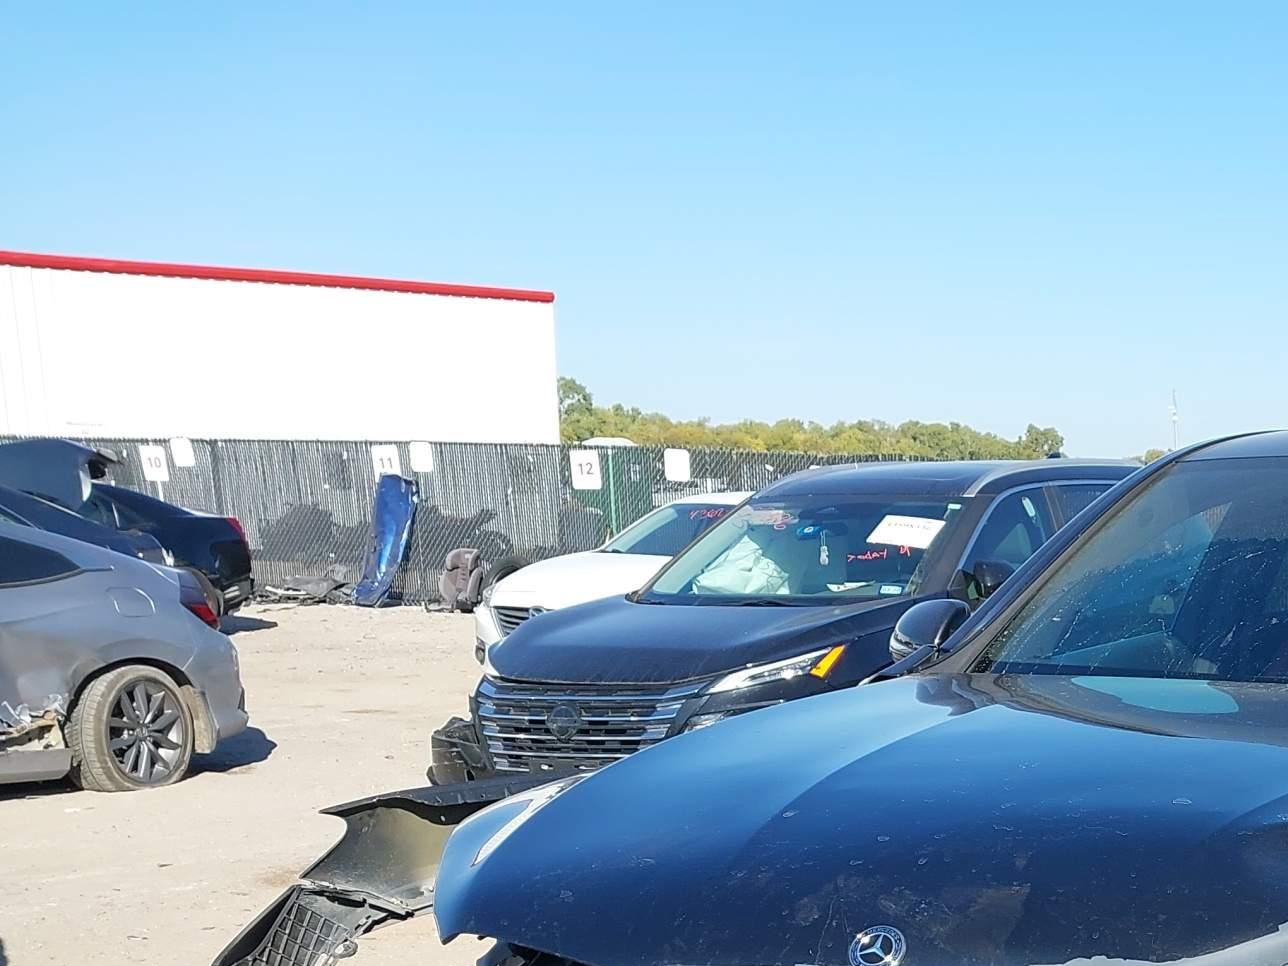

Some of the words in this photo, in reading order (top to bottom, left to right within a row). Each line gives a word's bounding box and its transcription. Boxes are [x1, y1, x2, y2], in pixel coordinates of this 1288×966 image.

[147, 456, 161, 468] 10
[379, 457, 393, 469] 11
[578, 461, 595, 476] 12
